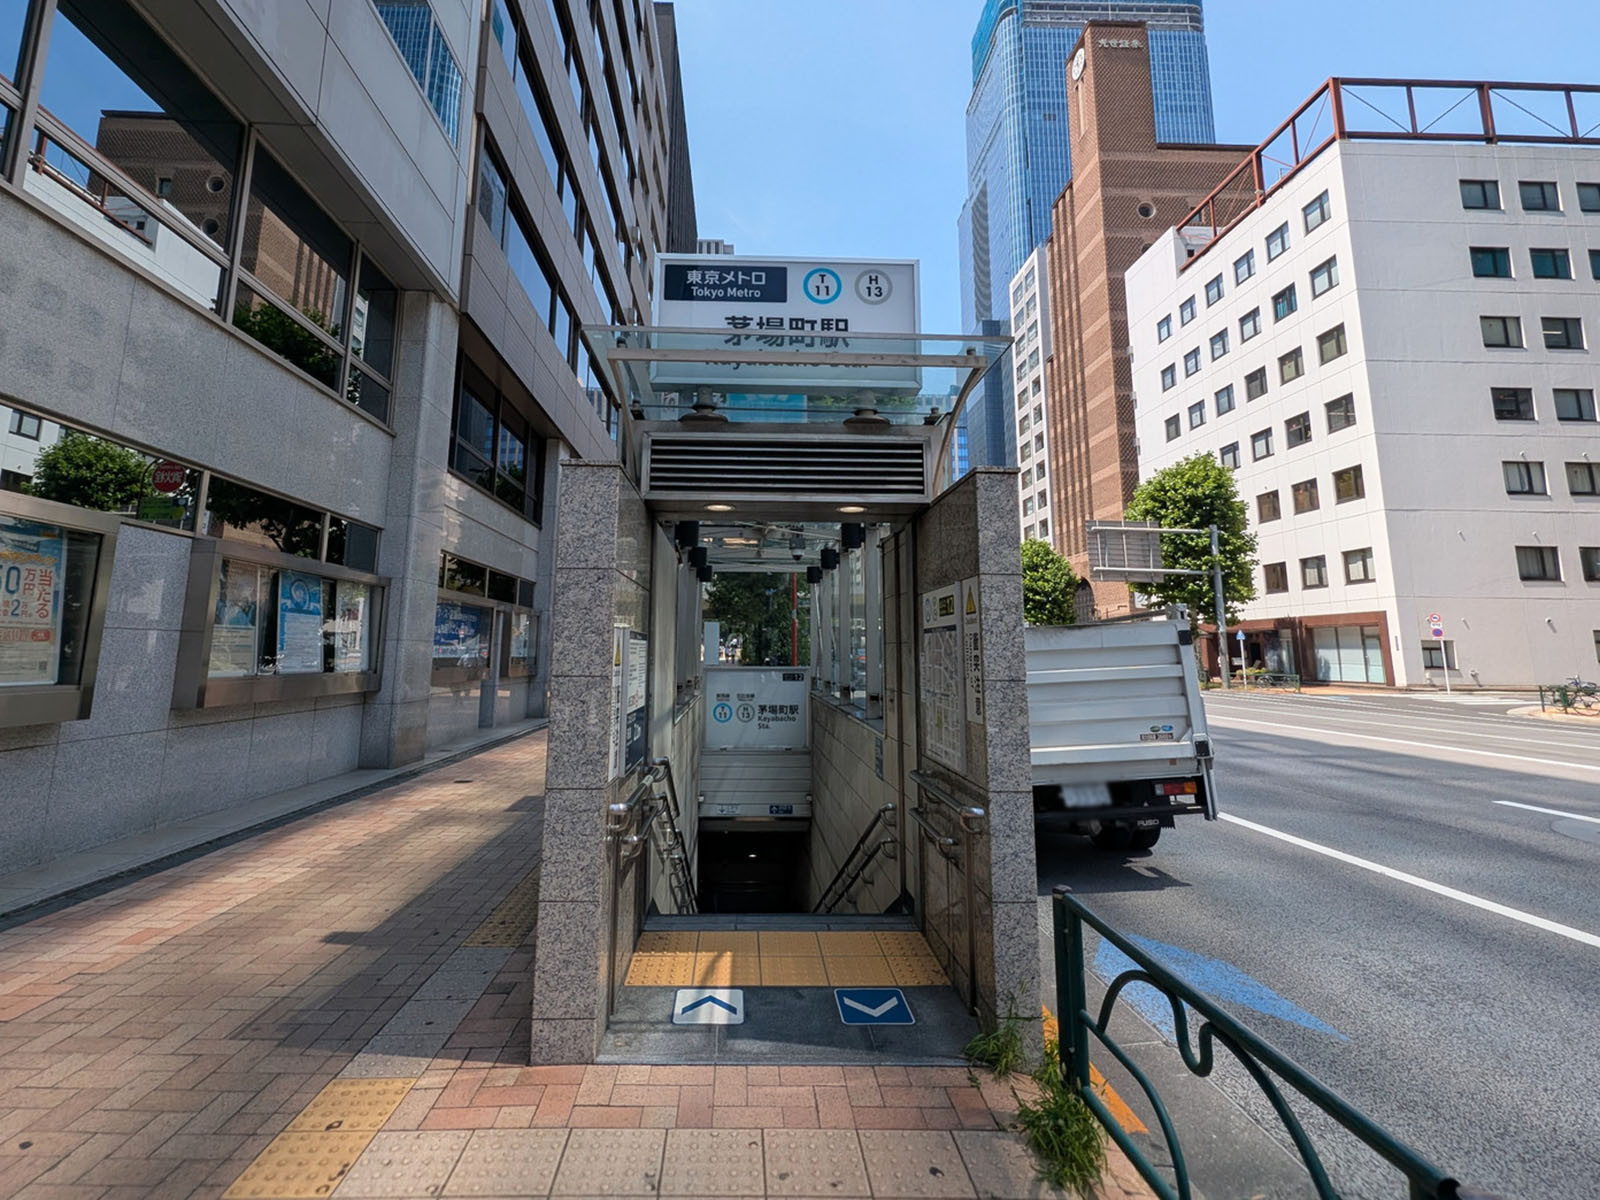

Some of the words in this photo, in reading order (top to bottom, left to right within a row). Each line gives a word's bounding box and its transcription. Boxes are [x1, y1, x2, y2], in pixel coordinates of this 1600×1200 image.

[686, 270, 766, 285] 東京メトロ
[819, 274, 826, 284] T
[869, 275, 878, 285] H
[691, 286, 724, 298] Tokyo
[727, 287, 761, 298] Metro
[814, 286, 831, 296] 11
[865, 286, 883, 297] 13
[724, 316, 850, 347] 茅場町駅
[0, 565, 21, 594] 0
[36, 569, 53, 618] 当たる
[11, 599, 20, 617] 2
[757, 705, 799, 715] 茅場町駅
